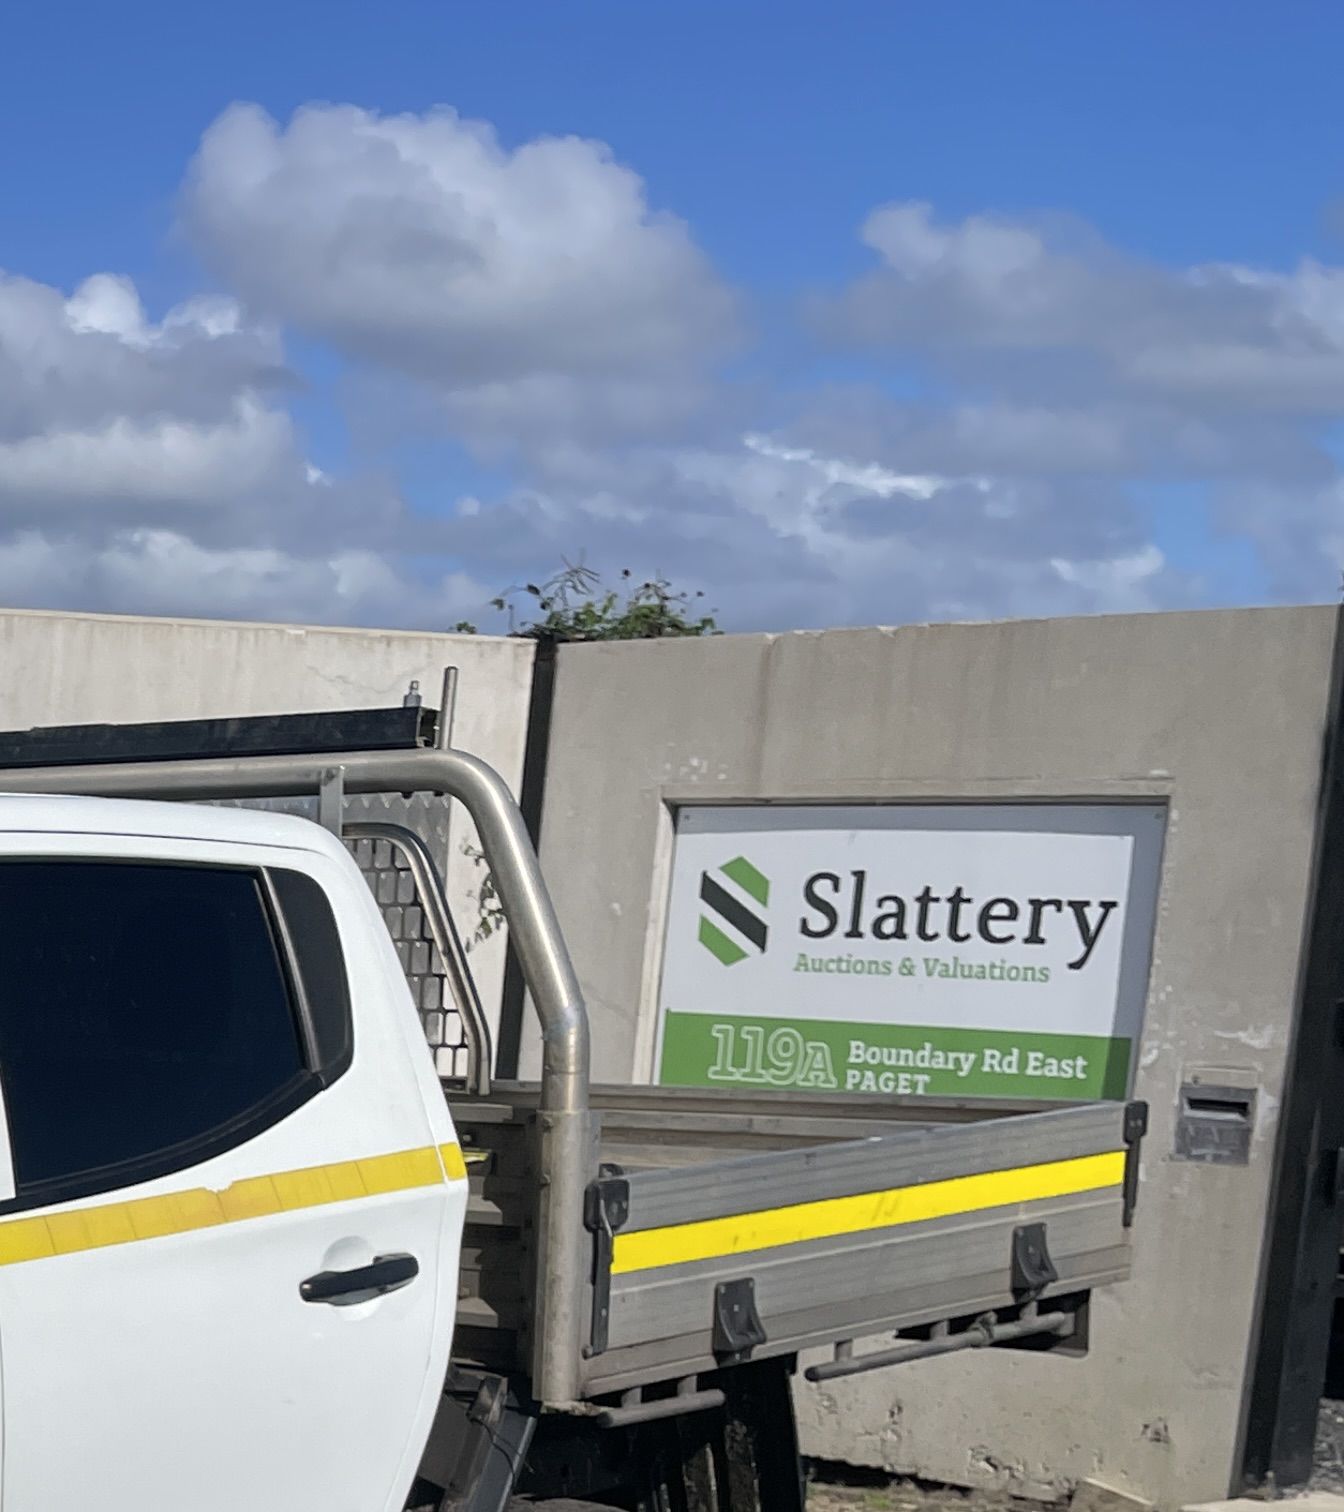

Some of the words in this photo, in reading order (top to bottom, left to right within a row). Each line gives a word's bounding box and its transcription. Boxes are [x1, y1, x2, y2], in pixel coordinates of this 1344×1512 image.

[799, 870, 1119, 970] Slattery
[794, 953, 892, 976] Auctions
[898, 957, 916, 977] &
[924, 957, 1050, 983] Valuations
[708, 1024, 838, 1089] 119A
[847, 1040, 976, 1075] Boundary
[983, 1046, 1020, 1077] Rd
[1025, 1049, 1088, 1080] East
[845, 1070, 931, 1095] PAGET
